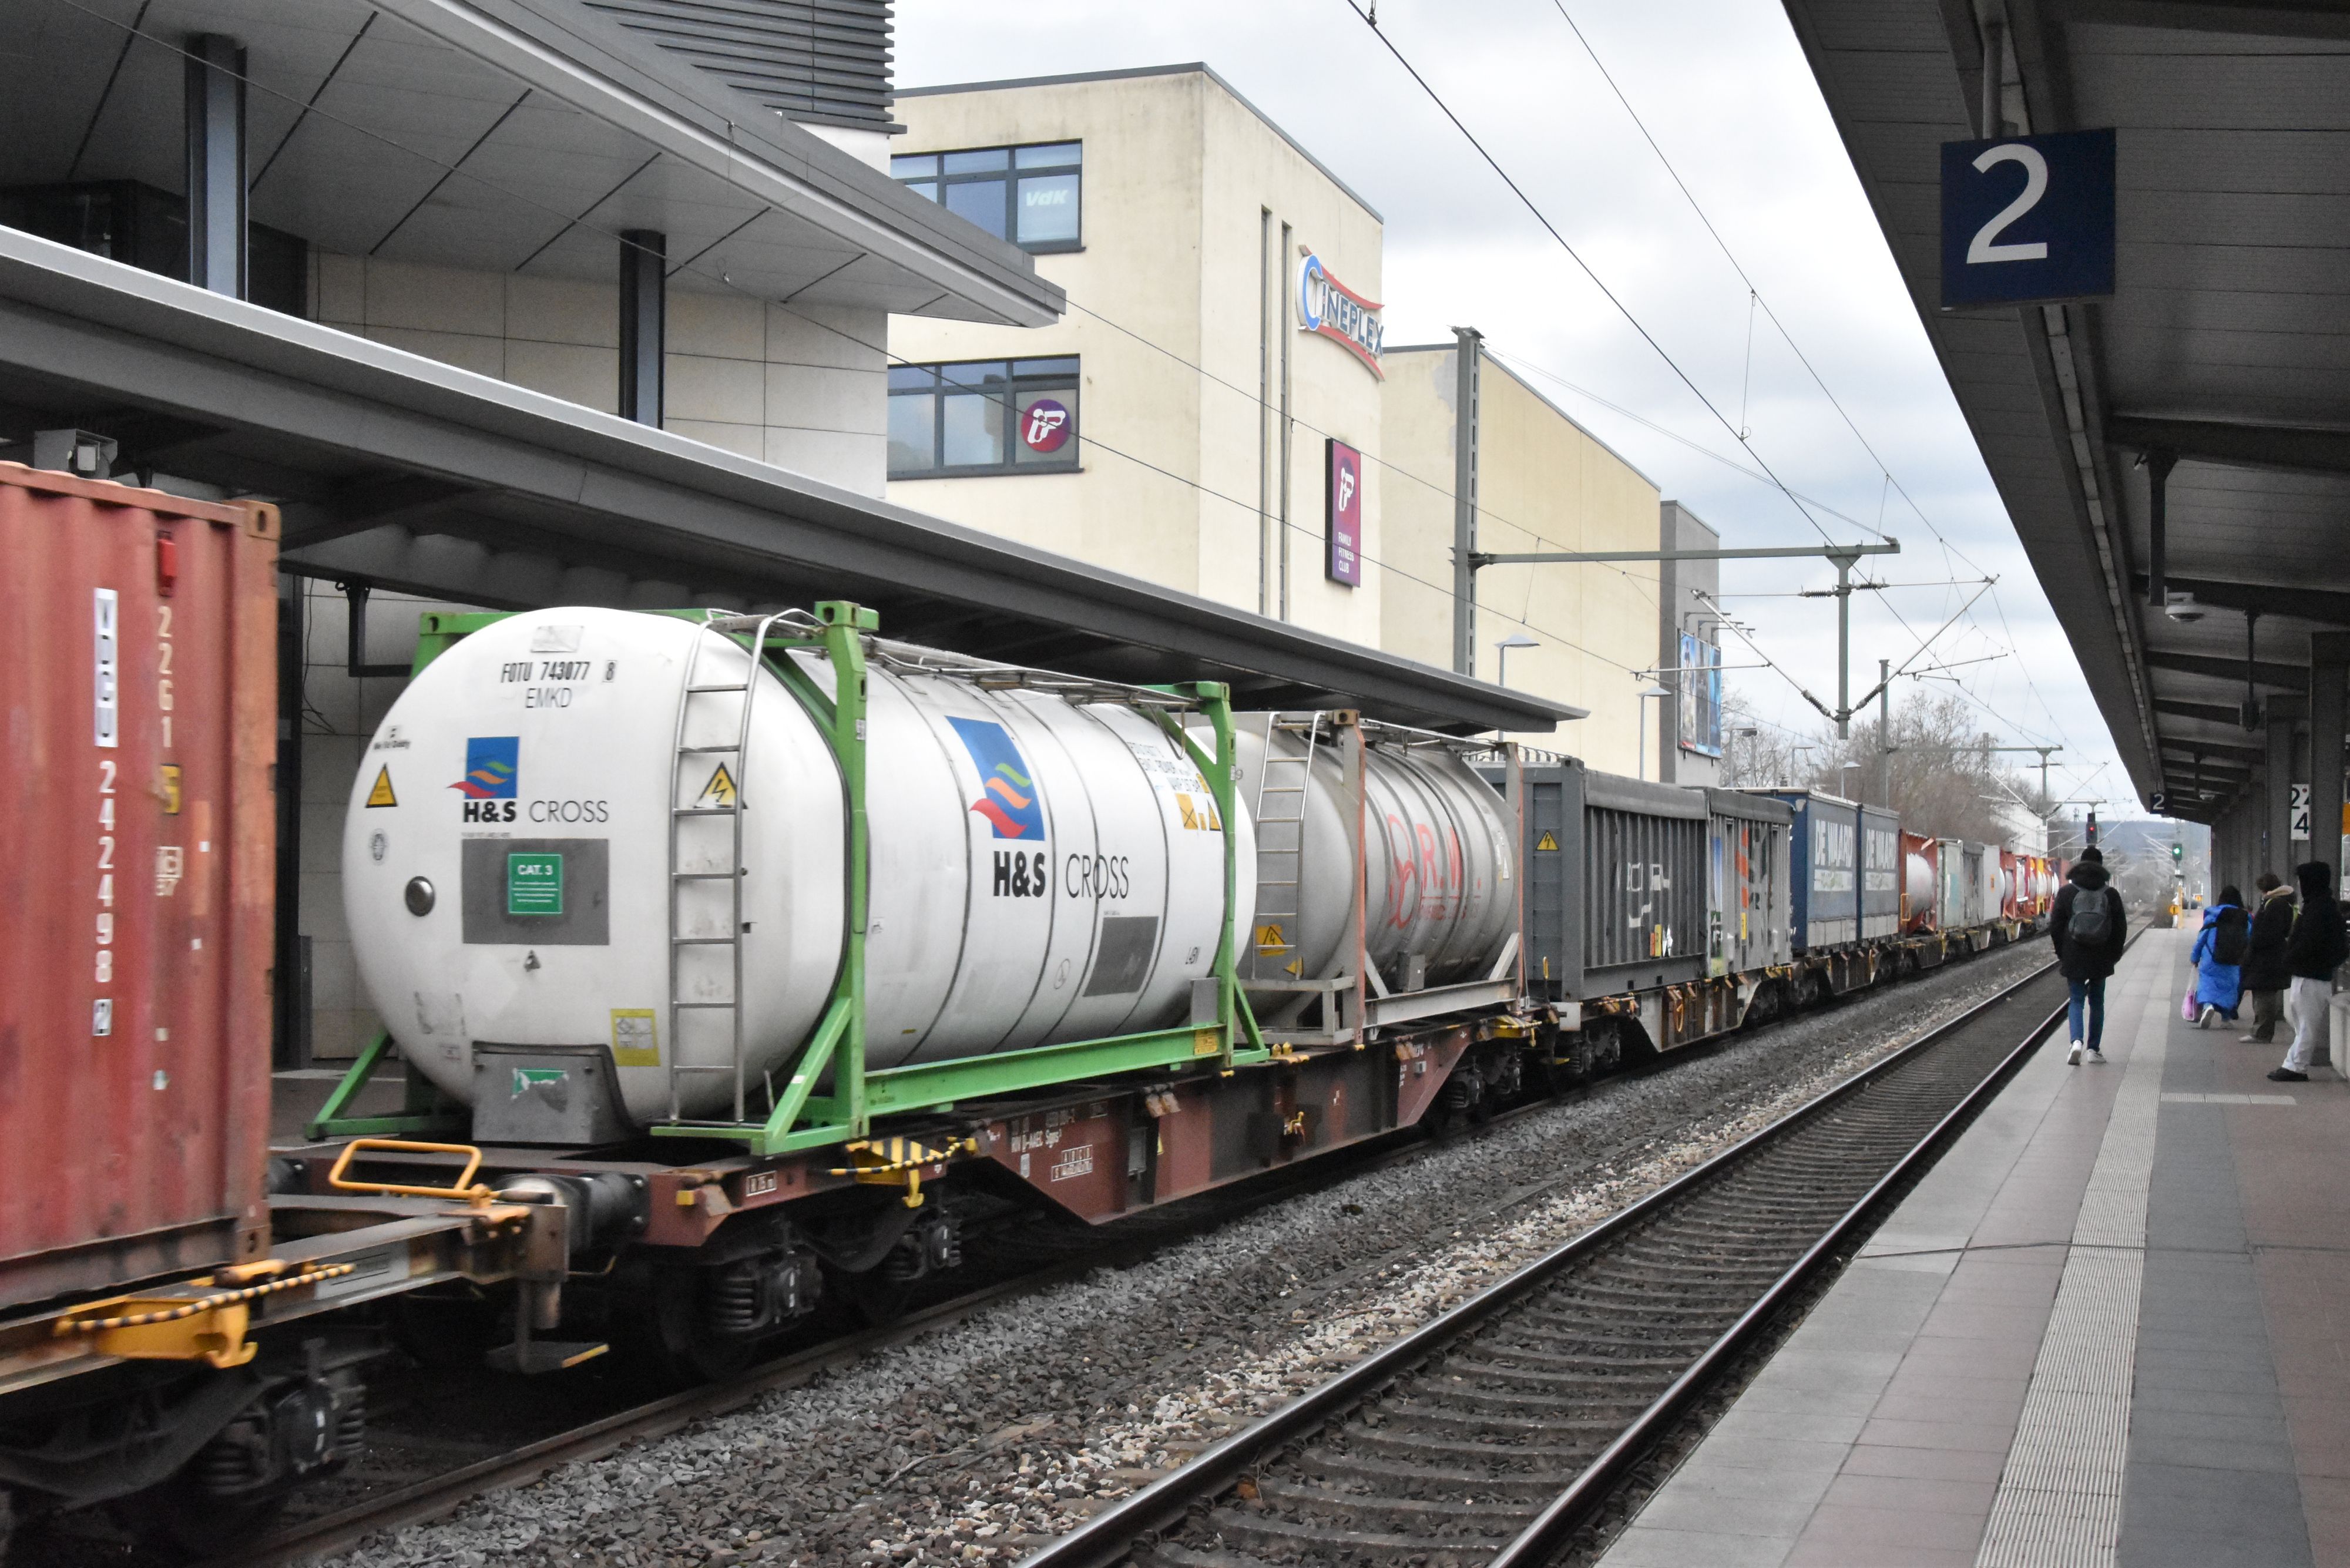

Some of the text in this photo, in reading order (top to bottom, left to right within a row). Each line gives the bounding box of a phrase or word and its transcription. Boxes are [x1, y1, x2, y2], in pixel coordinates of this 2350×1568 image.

[1026, 189, 1068, 207] VdK
[1966, 144, 2048, 264] 2
[1300, 254, 1384, 357] CINEPLEX
[1338, 532, 1352, 547] FAMILY
[1338, 547, 1354, 562] FITNESS
[1339, 560, 1349, 574] CLUB
[501, 661, 616, 683] FOTU 743077 8
[525, 687, 573, 709] EMKD
[463, 800, 609, 823] H&S CROSS
[2153, 794, 2165, 810] 2
[2294, 812, 2309, 834] 4
[1815, 819, 1826, 865] DE
[545, 864, 553, 875] 3
[993, 851, 1129, 899] H&S CROSS
